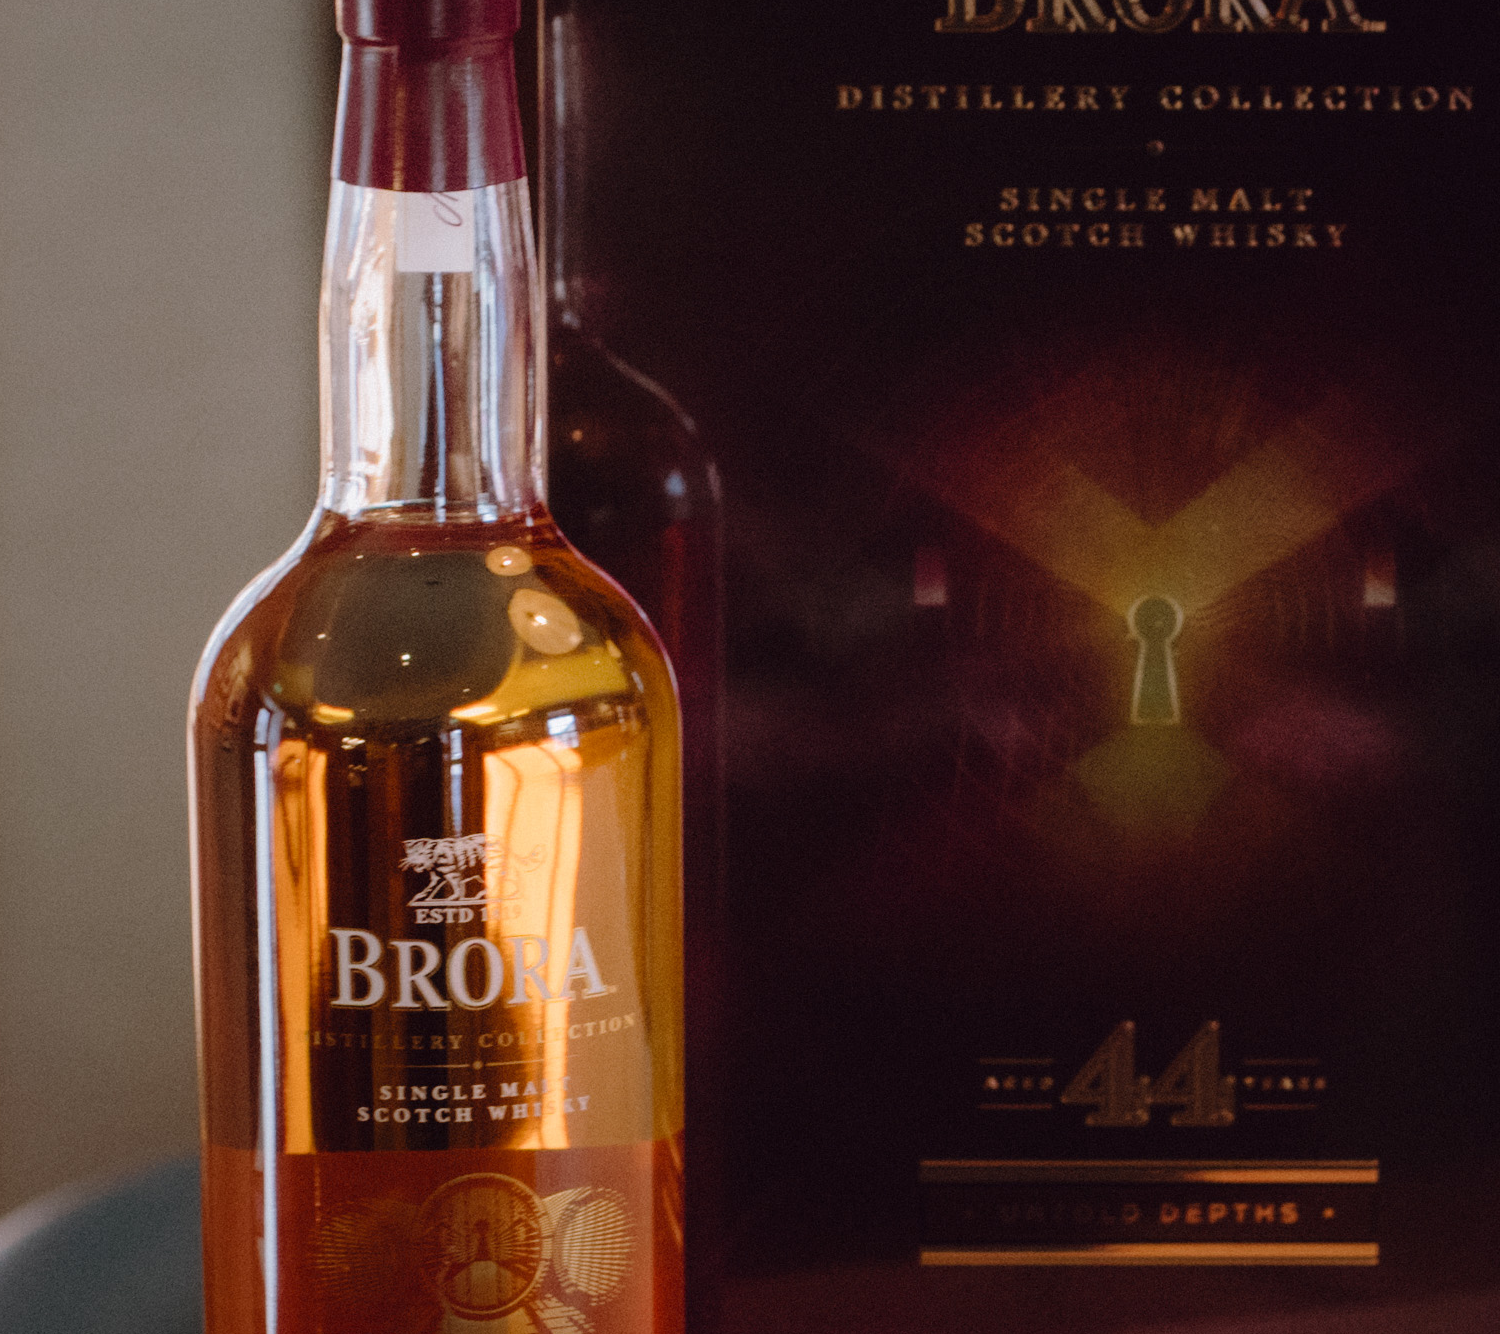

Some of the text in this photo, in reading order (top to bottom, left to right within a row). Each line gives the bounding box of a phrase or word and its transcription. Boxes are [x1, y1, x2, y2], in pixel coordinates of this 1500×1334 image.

[836, 84, 1476, 113] DISTILLERY COLLECTION
[999, 187, 1316, 214] SINGLE MALT
[963, 222, 1347, 250] SCOTCH WHISKY
[415, 907, 474, 924] ESTD
[329, 926, 611, 1011] BRORA
[304, 1028, 464, 1051] ISTILLERY
[1058, 1018, 1238, 1129] 44
[377, 1083, 487, 1103] SINGLE
[356, 1094, 592, 1124] SCOTCH WHISKY
[1157, 1199, 1301, 1227] DEPTHS
